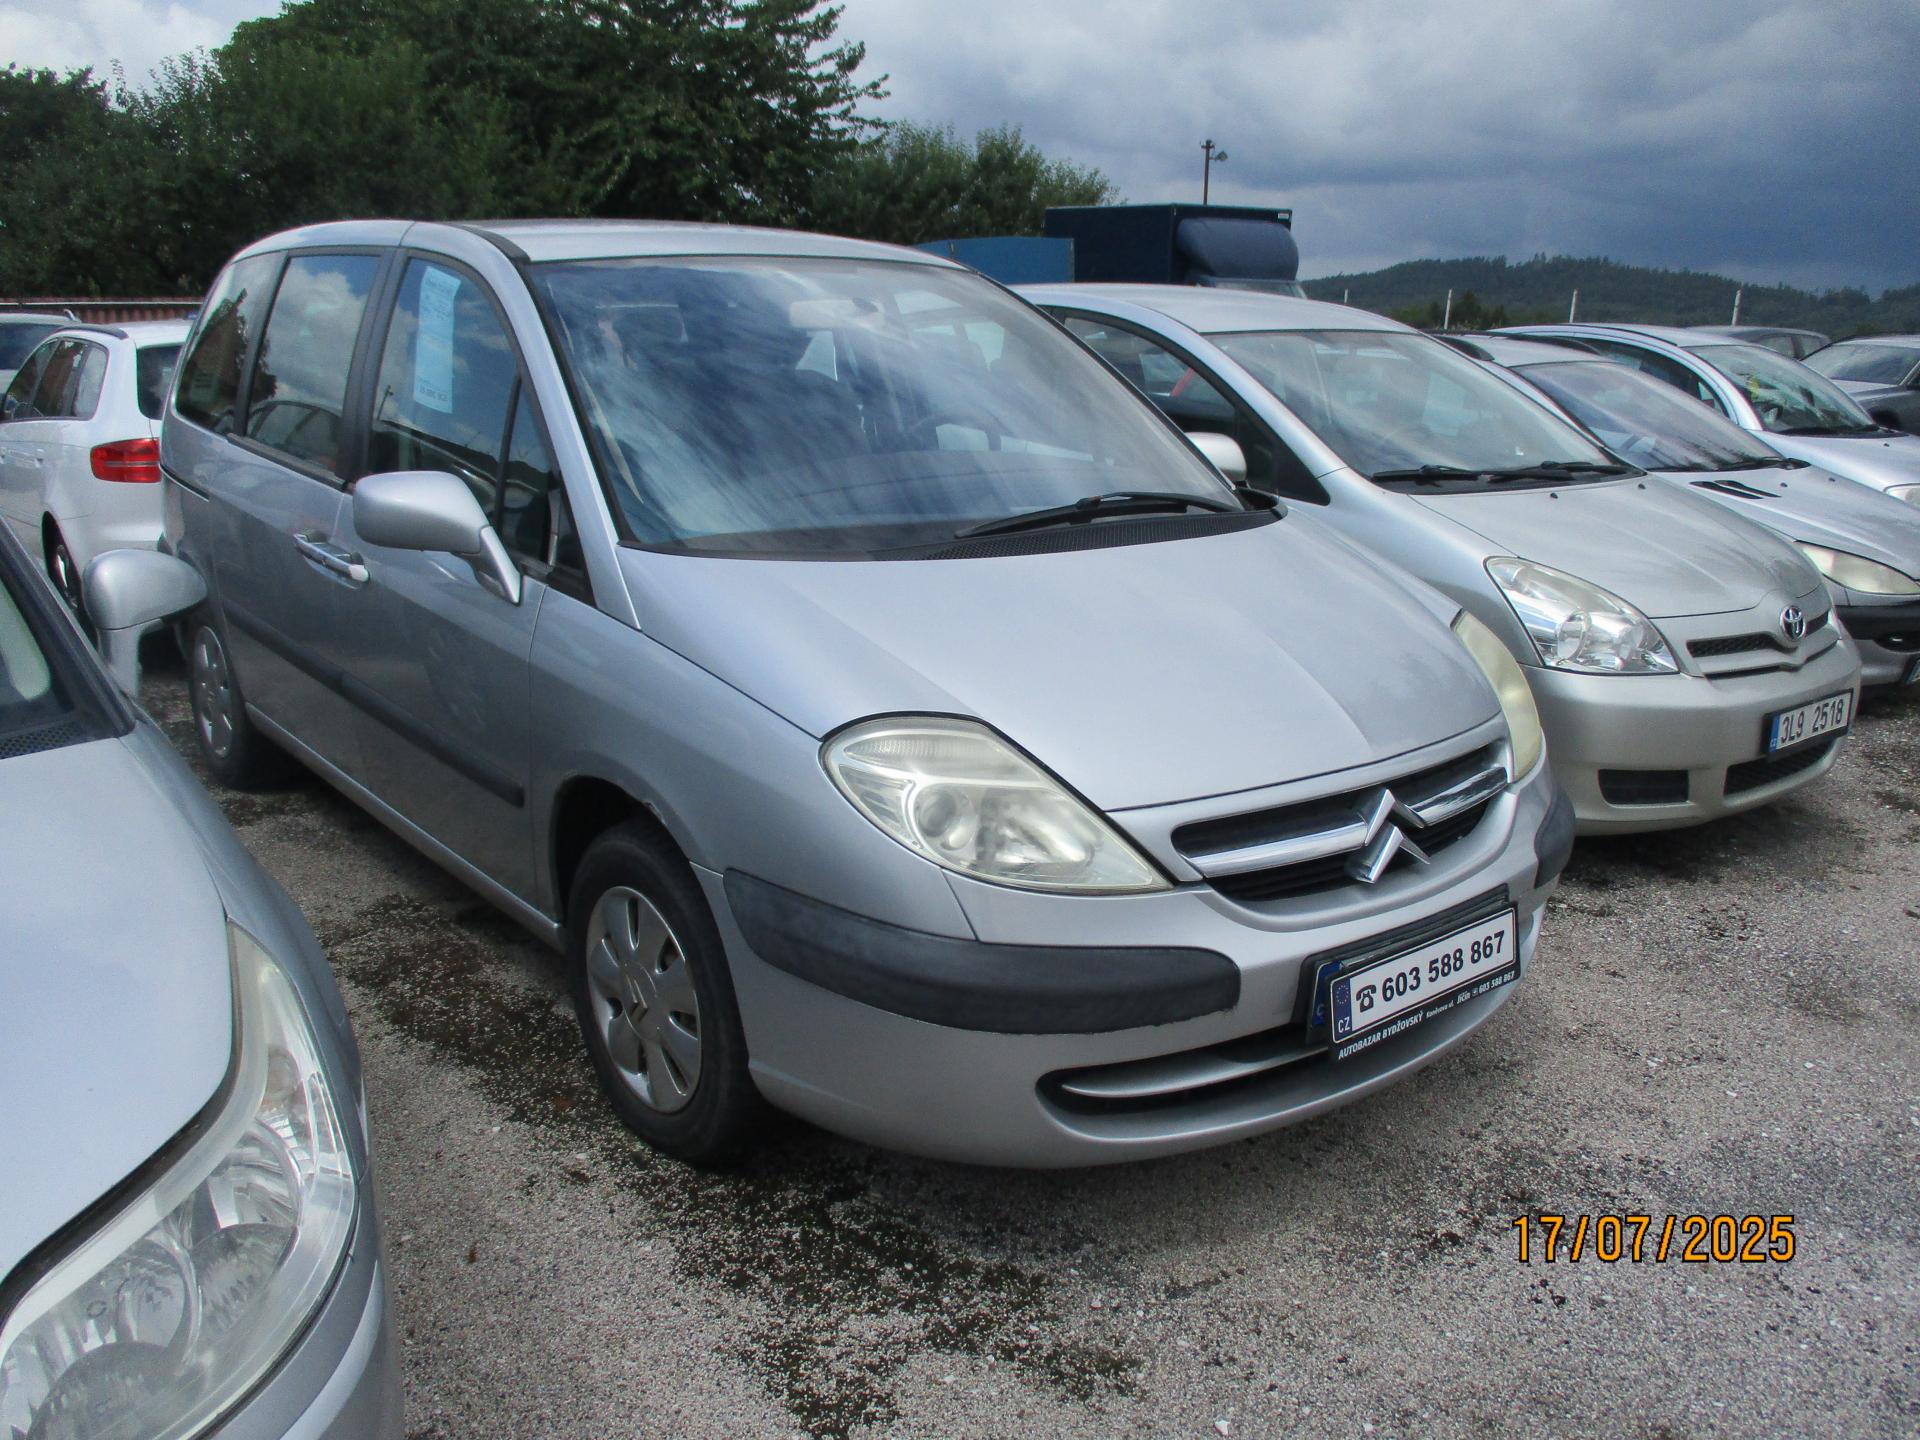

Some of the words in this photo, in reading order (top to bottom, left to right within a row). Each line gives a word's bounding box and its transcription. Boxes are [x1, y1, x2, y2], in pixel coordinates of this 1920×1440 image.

[1781, 711, 1804, 743] 3L9
[1812, 699, 1843, 732] 2518
[1382, 966, 1421, 1002] 603
[1428, 948, 1464, 983] 588
[1470, 930, 1505, 964] 867
[1338, 1016, 1350, 1033] CZ
[1338, 1031, 1381, 1060] AUTOBAZAR
[1382, 1010, 1424, 1039] BYDŽOVSKÝ
